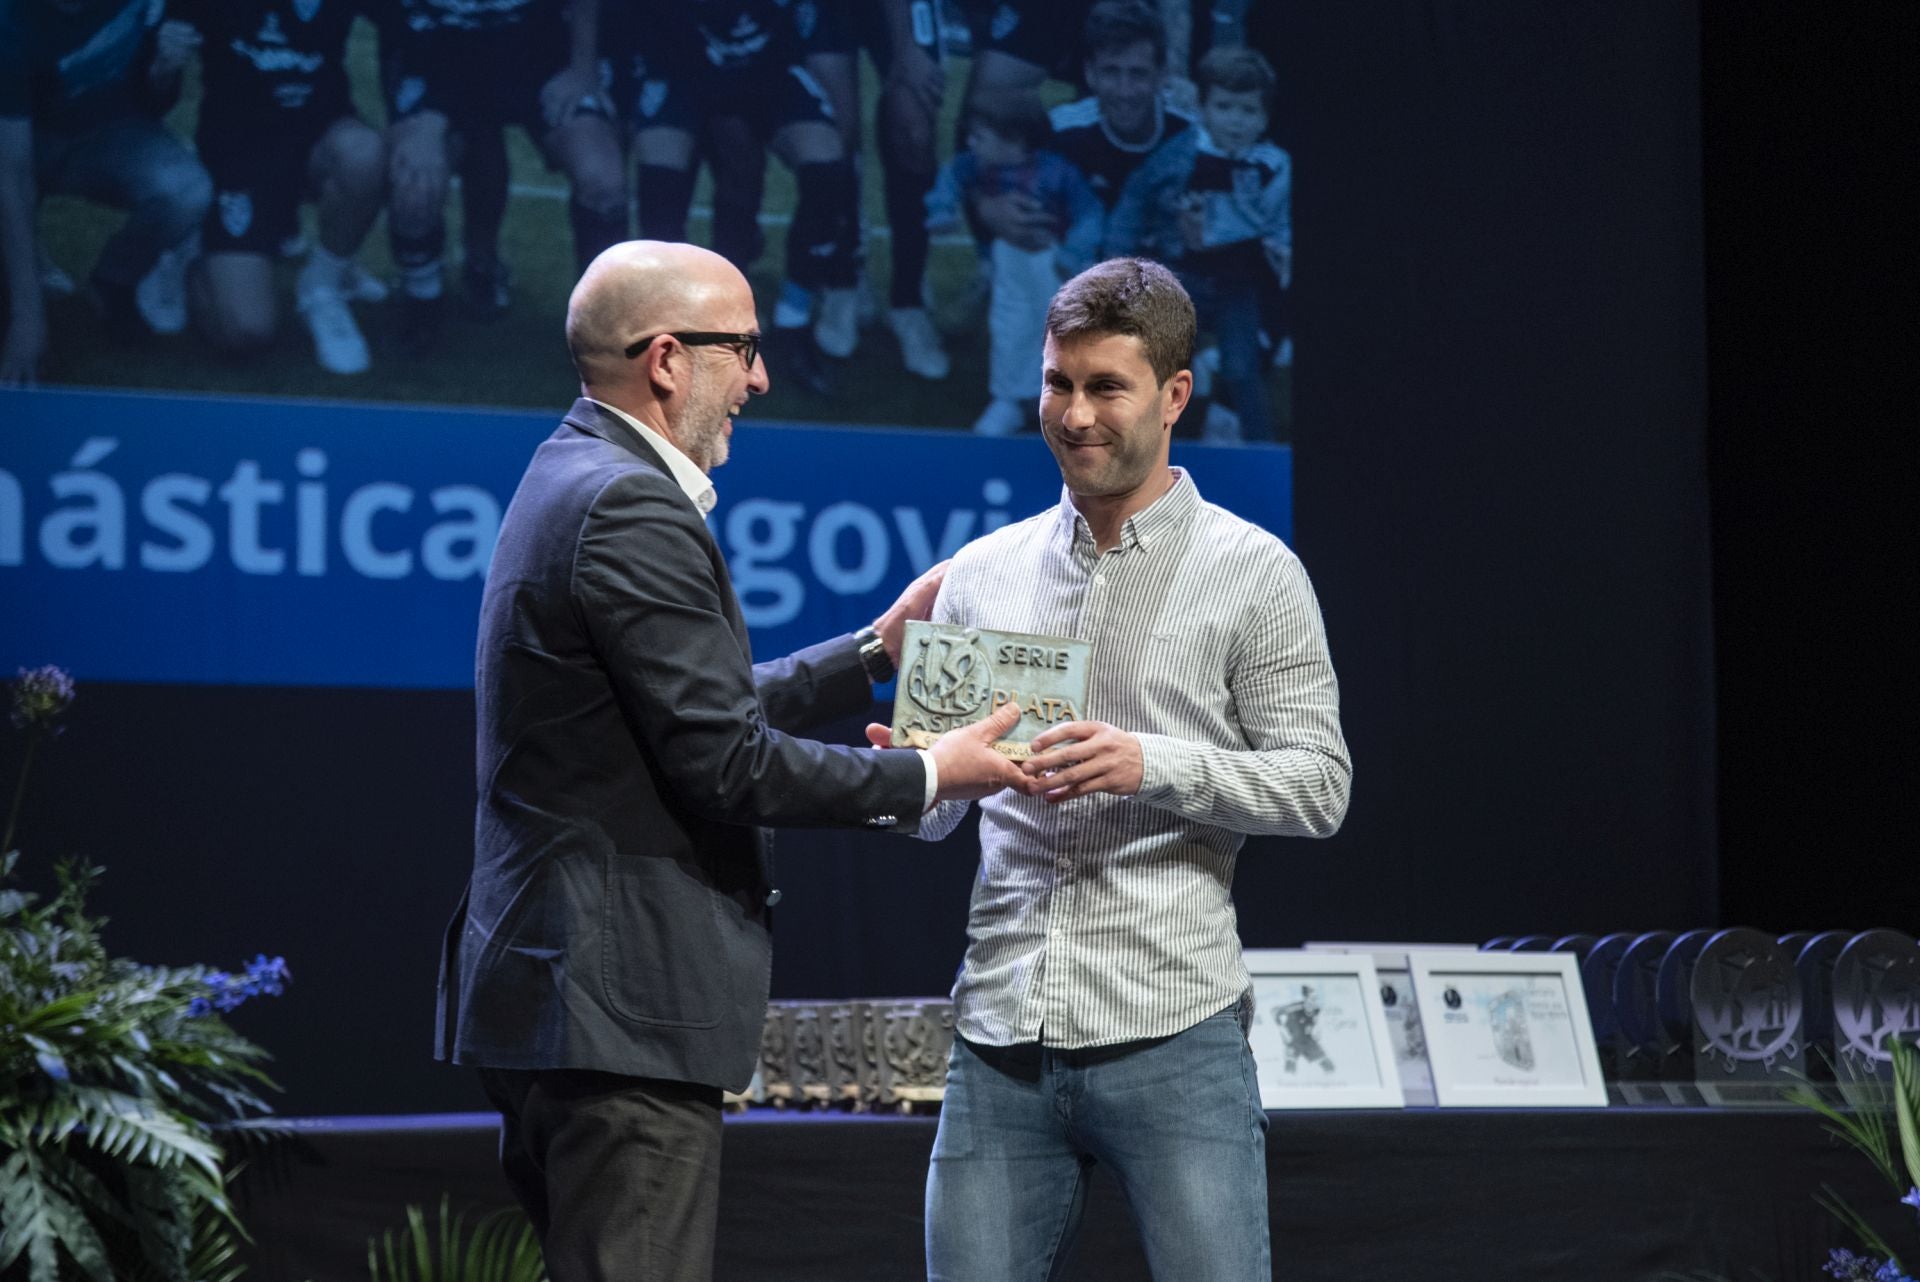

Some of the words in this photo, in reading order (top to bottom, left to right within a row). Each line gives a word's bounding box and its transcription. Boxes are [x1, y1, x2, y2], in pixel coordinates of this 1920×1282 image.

[703, 478, 1012, 628] govi
[998, 641, 1069, 670] SERIE
[906, 711, 977, 733] ASP
